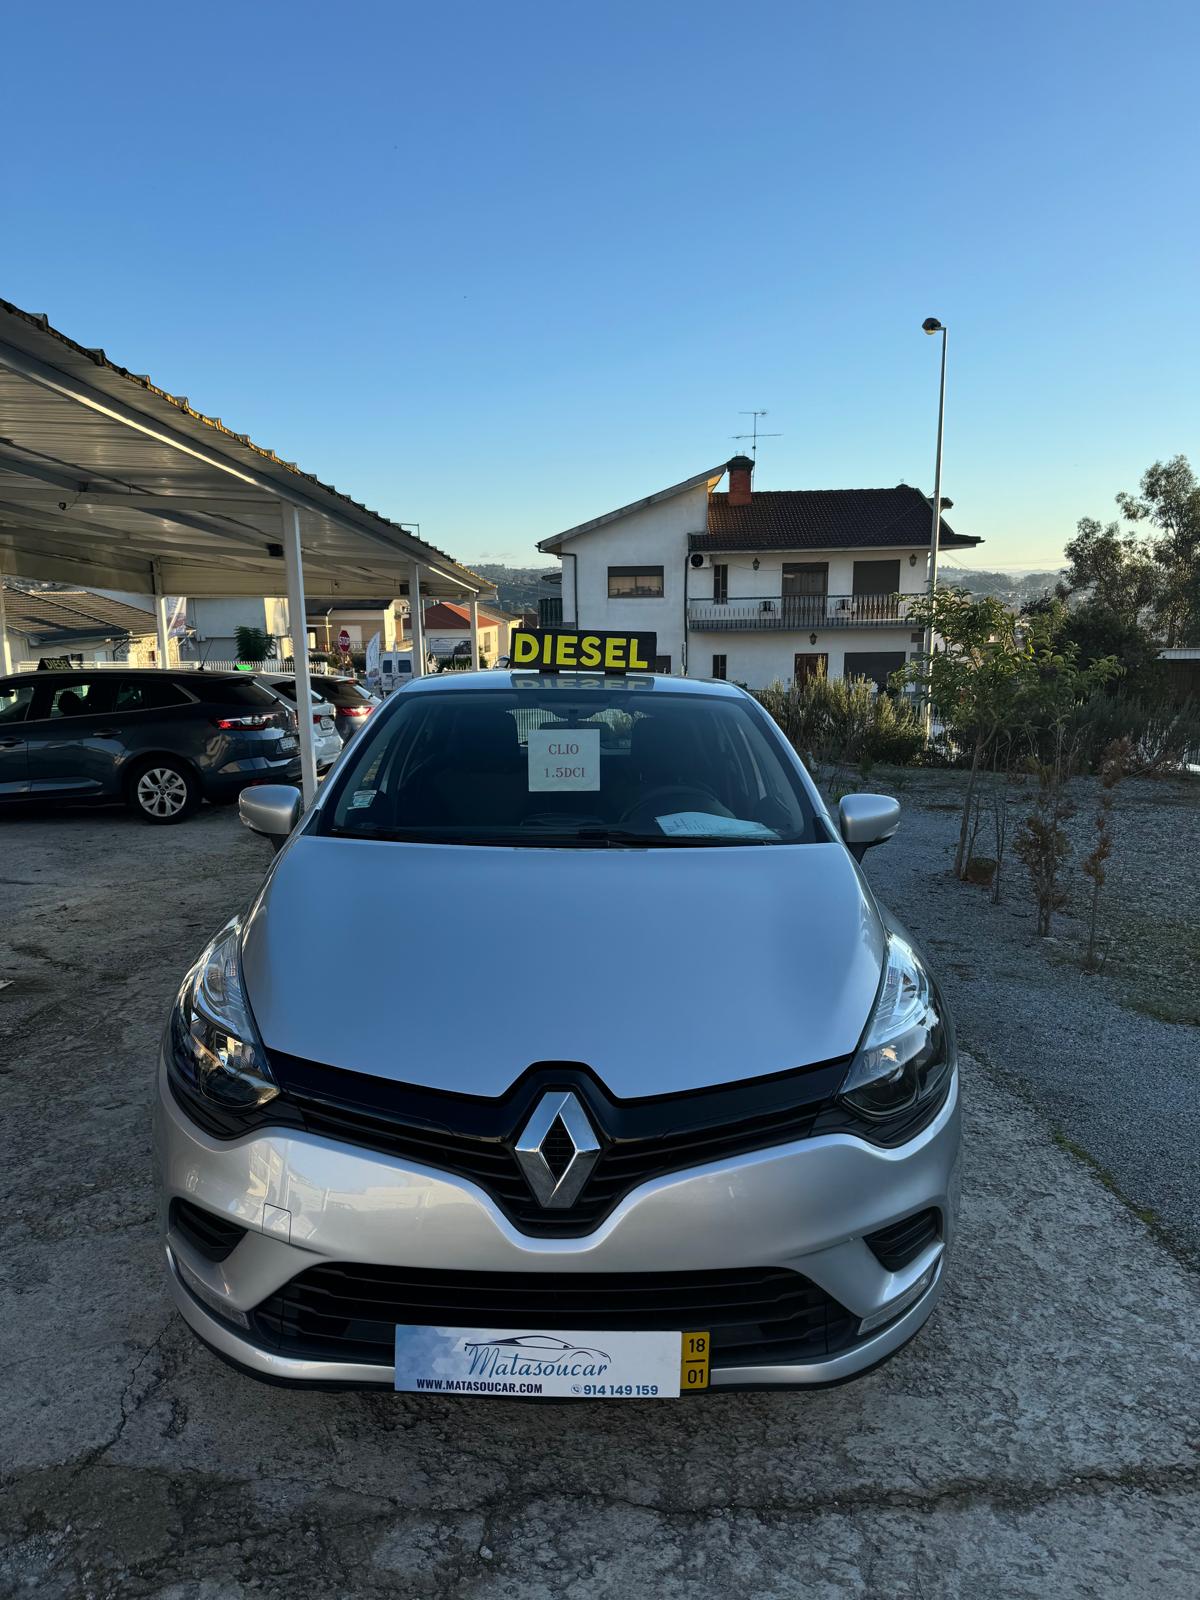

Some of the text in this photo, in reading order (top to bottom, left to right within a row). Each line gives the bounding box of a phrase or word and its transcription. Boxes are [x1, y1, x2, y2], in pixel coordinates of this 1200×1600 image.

[339, 636, 350, 646] STOP
[514, 633, 648, 669] DIESEL
[44, 659, 71, 669] DIESEL
[548, 744, 579, 755] CLIO
[544, 767, 585, 778] 1.5DCI
[688, 1337, 706, 1353] 18
[467, 1344, 607, 1378] Matasoucar
[687, 1369, 705, 1384] 01
[416, 1378, 543, 1394] WWW.MATASOUCAR.COM
[583, 1384, 659, 1396] 914 149 159
